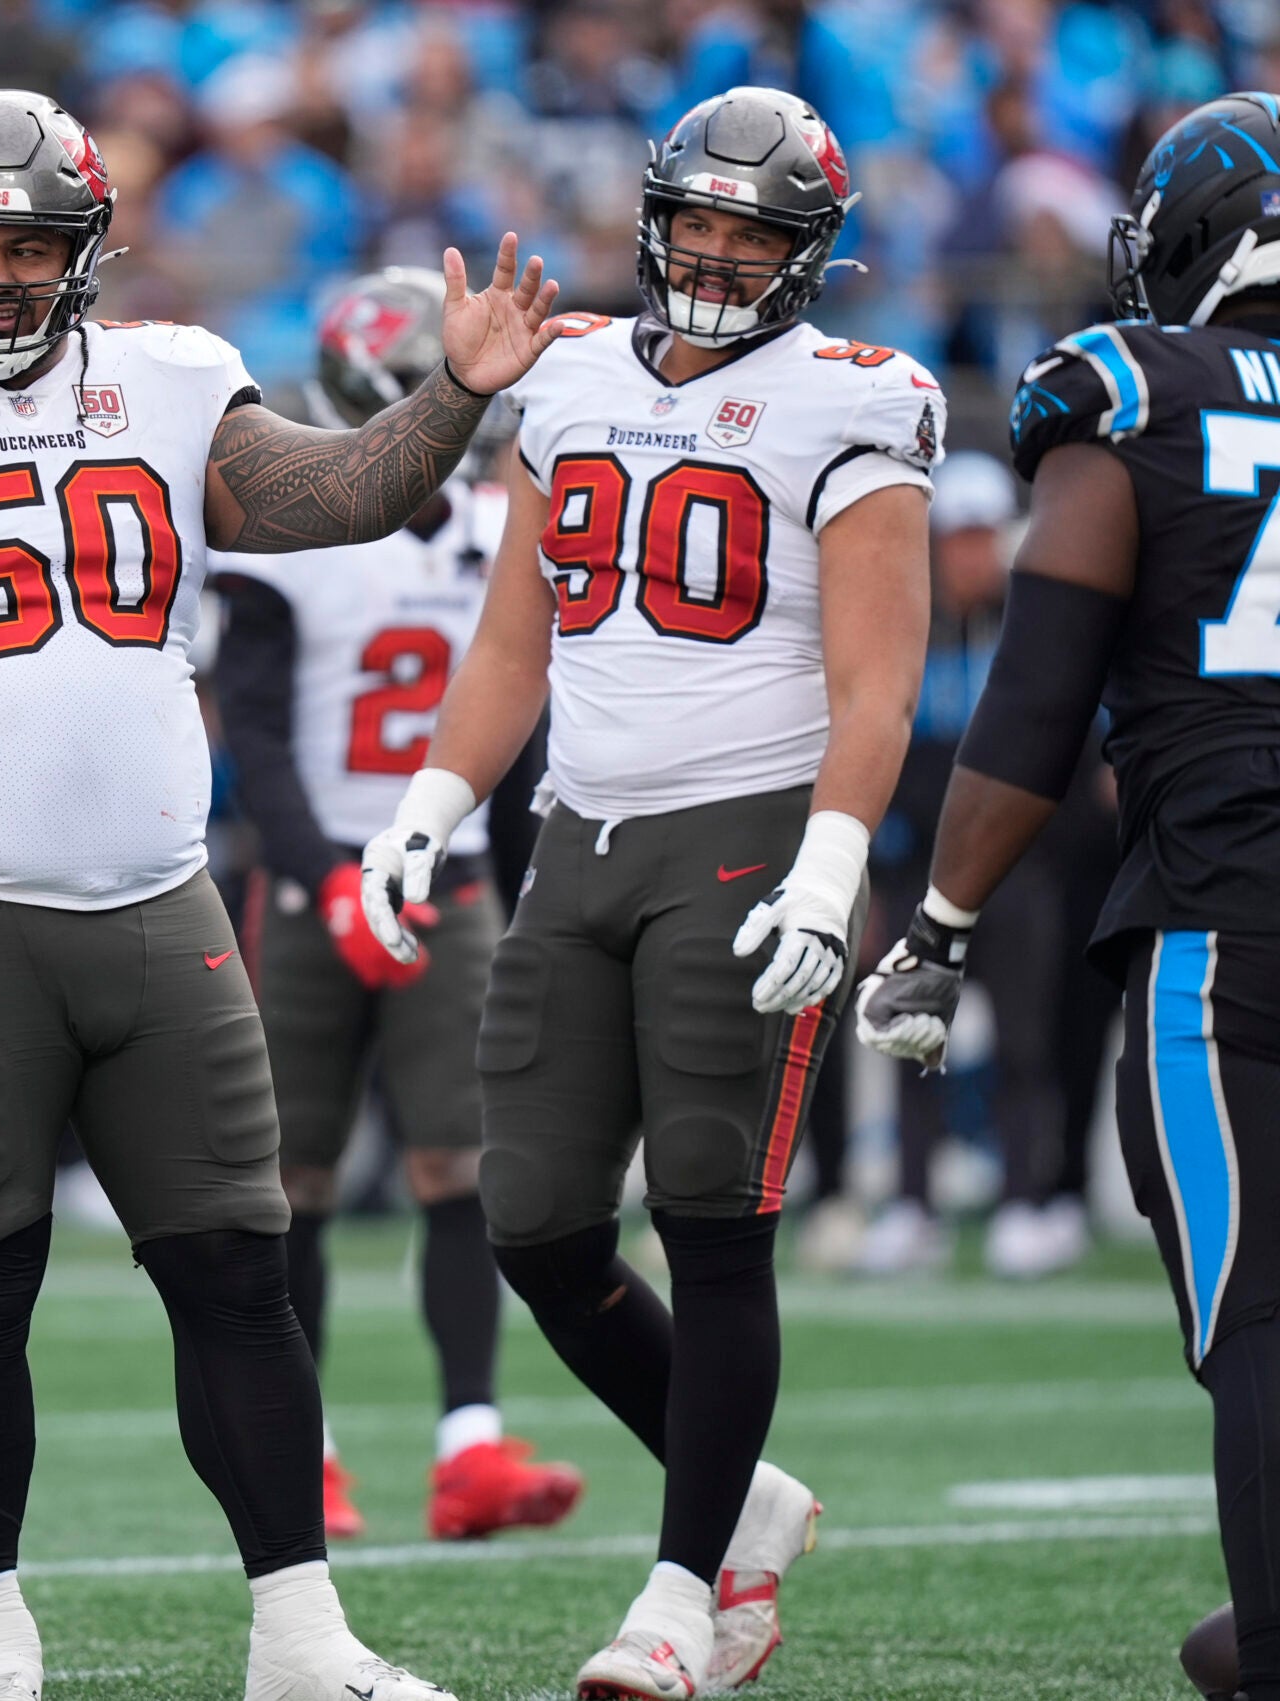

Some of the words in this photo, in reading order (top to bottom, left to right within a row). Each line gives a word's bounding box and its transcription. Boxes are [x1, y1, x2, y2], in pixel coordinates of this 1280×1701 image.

[82, 389, 120, 414] 50
[717, 401, 756, 428] 50
[540, 452, 771, 645] 90
